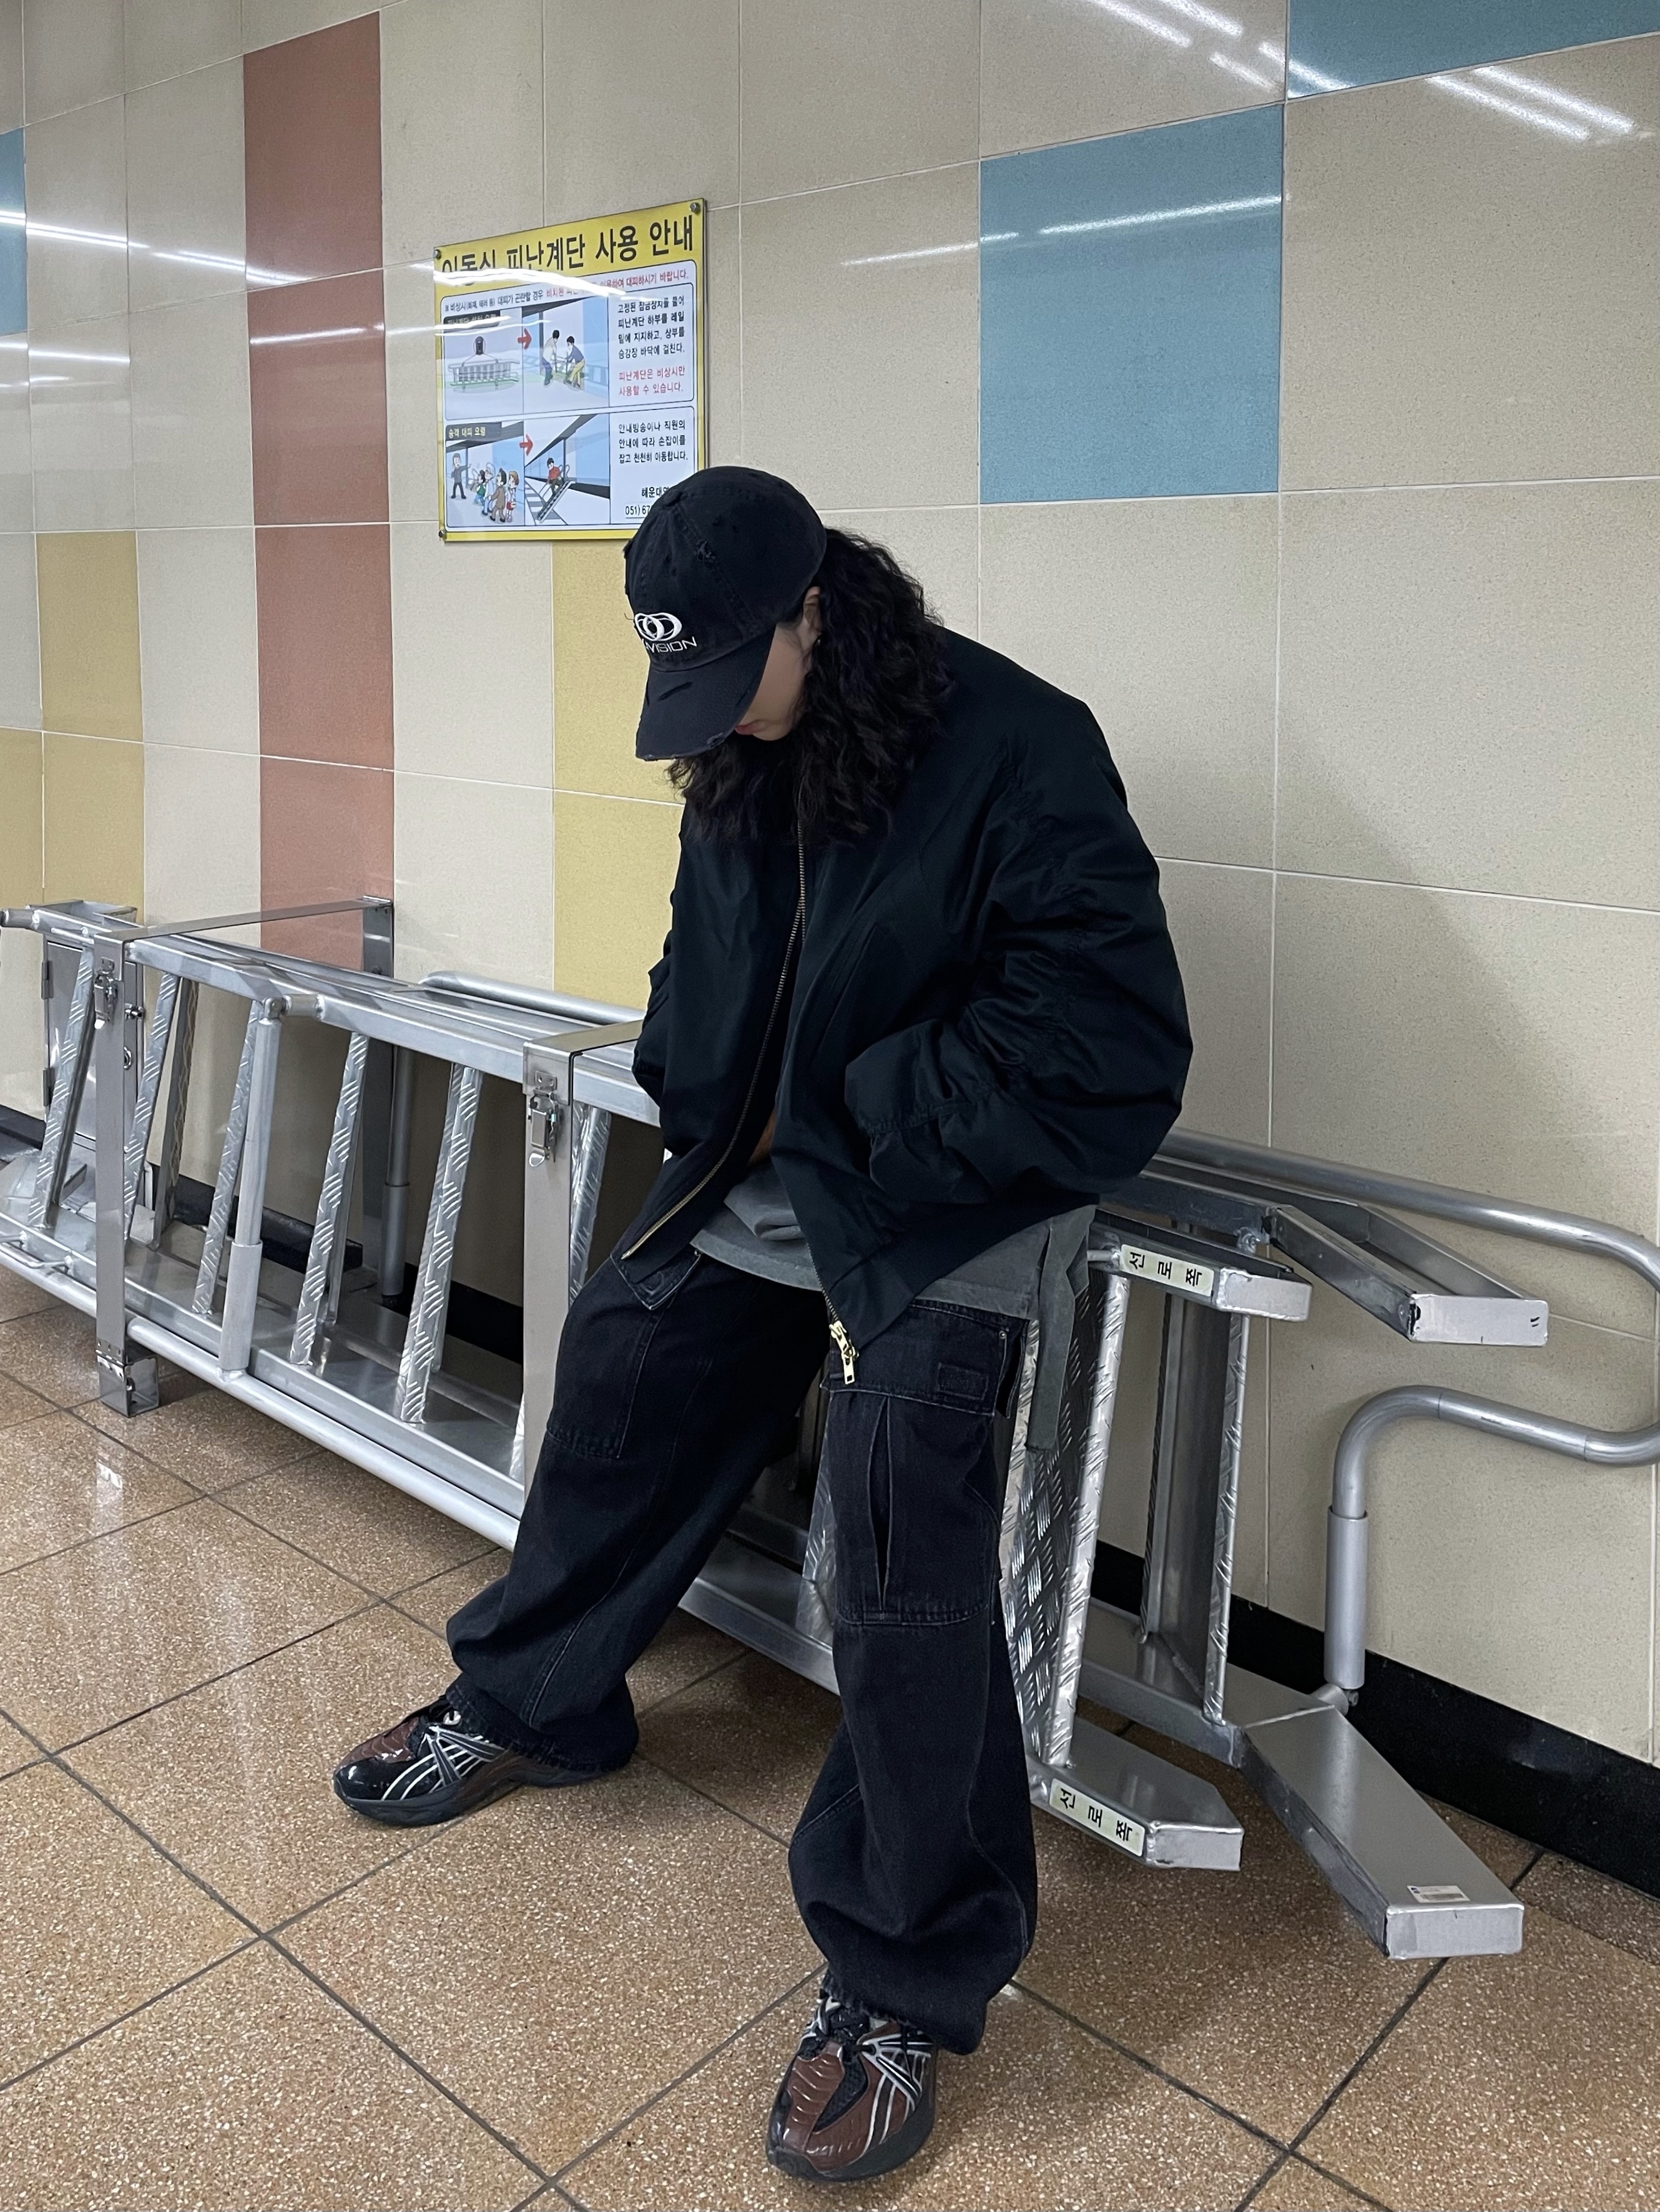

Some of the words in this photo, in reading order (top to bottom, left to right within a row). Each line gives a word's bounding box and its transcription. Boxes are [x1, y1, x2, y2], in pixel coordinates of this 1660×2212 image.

[506, 233, 586, 272] 피난계단
[596, 225, 639, 263] 사용
[649, 215, 693, 257] 안내
[498, 294, 514, 305] 대피가
[533, 290, 543, 301] 경우
[626, 273, 656, 286] 대피하시기
[660, 269, 689, 282] 바랍니다.
[617, 302, 636, 313] 고정된
[672, 295, 685, 307] 풀어
[618, 316, 645, 329] 피난계단
[647, 313, 667, 325] 하부를
[670, 311, 684, 322] 레일
[634, 330, 662, 342] 지지하고,
[665, 326, 685, 340] 상부를
[618, 348, 638, 360] 승강장
[641, 345, 660, 356] 바닥에
[663, 342, 685, 355] 걸친다.
[619, 368, 654, 381] 피난계단은
[657, 365, 685, 378] 비상시만
[619, 385, 639, 396] 사용할
[643, 384, 649, 394] 수
[653, 381, 684, 394] 있습니다.
[664, 419, 685, 431] 직원의
[619, 438, 639, 449] 안내에
[642, 438, 655, 448] 따라
[619, 454, 631, 464] 잡고
[634, 453, 652, 463] 천천히
[655, 451, 688, 462] 이동합니다.
[625, 504, 641, 516] 051)
[642, 636, 697, 653] VISION
